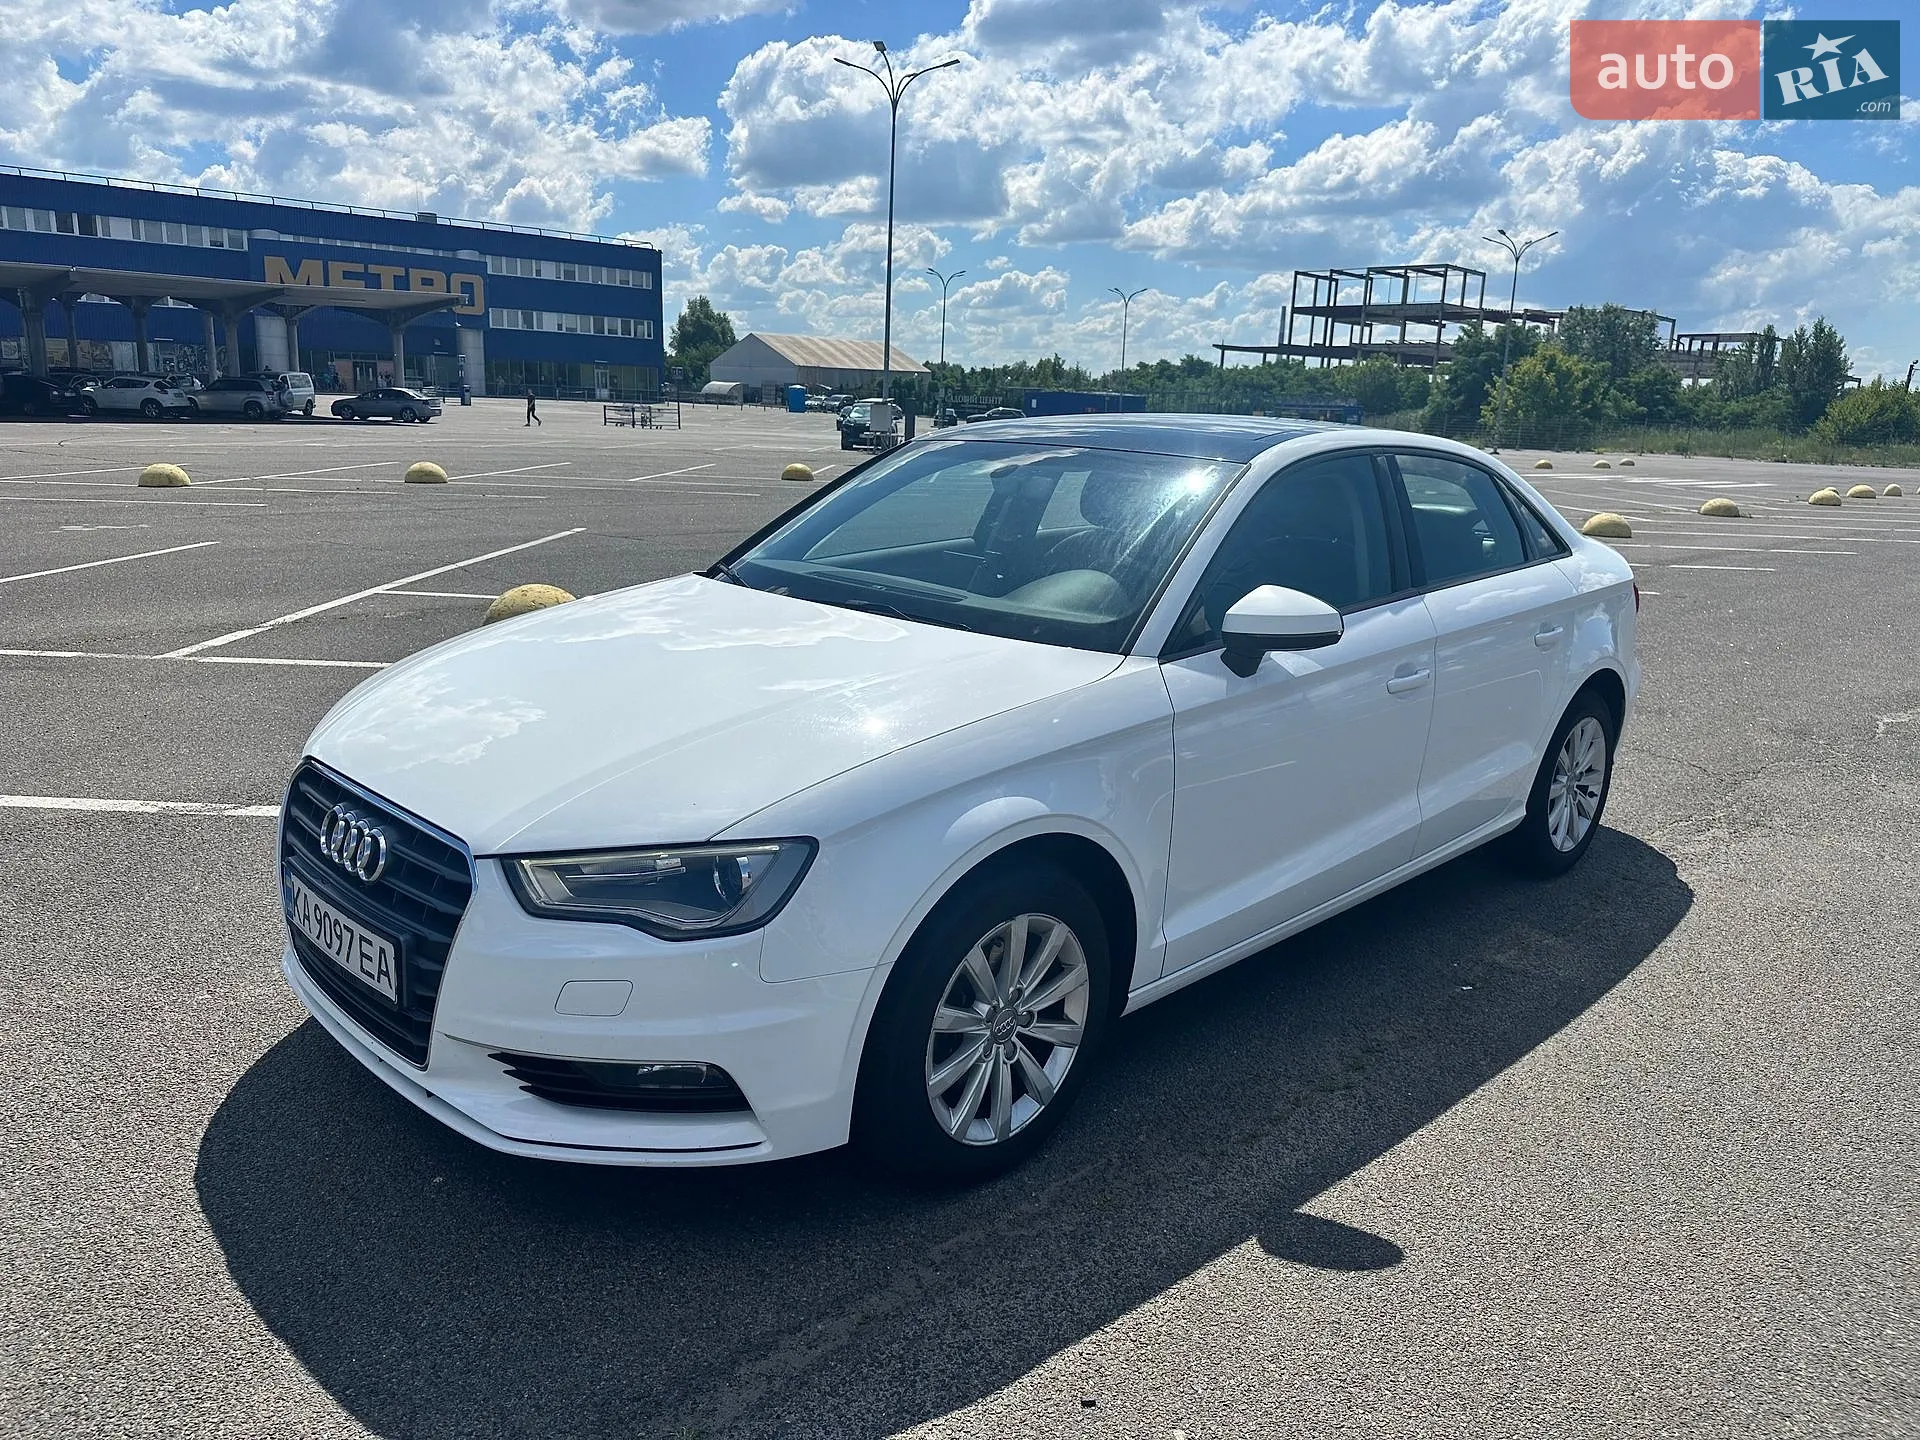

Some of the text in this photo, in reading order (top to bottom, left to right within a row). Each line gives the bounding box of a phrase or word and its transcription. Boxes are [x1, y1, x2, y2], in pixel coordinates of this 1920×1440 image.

[264, 256, 484, 316] METRO
[292, 882, 392, 990] KA 9097 EA
